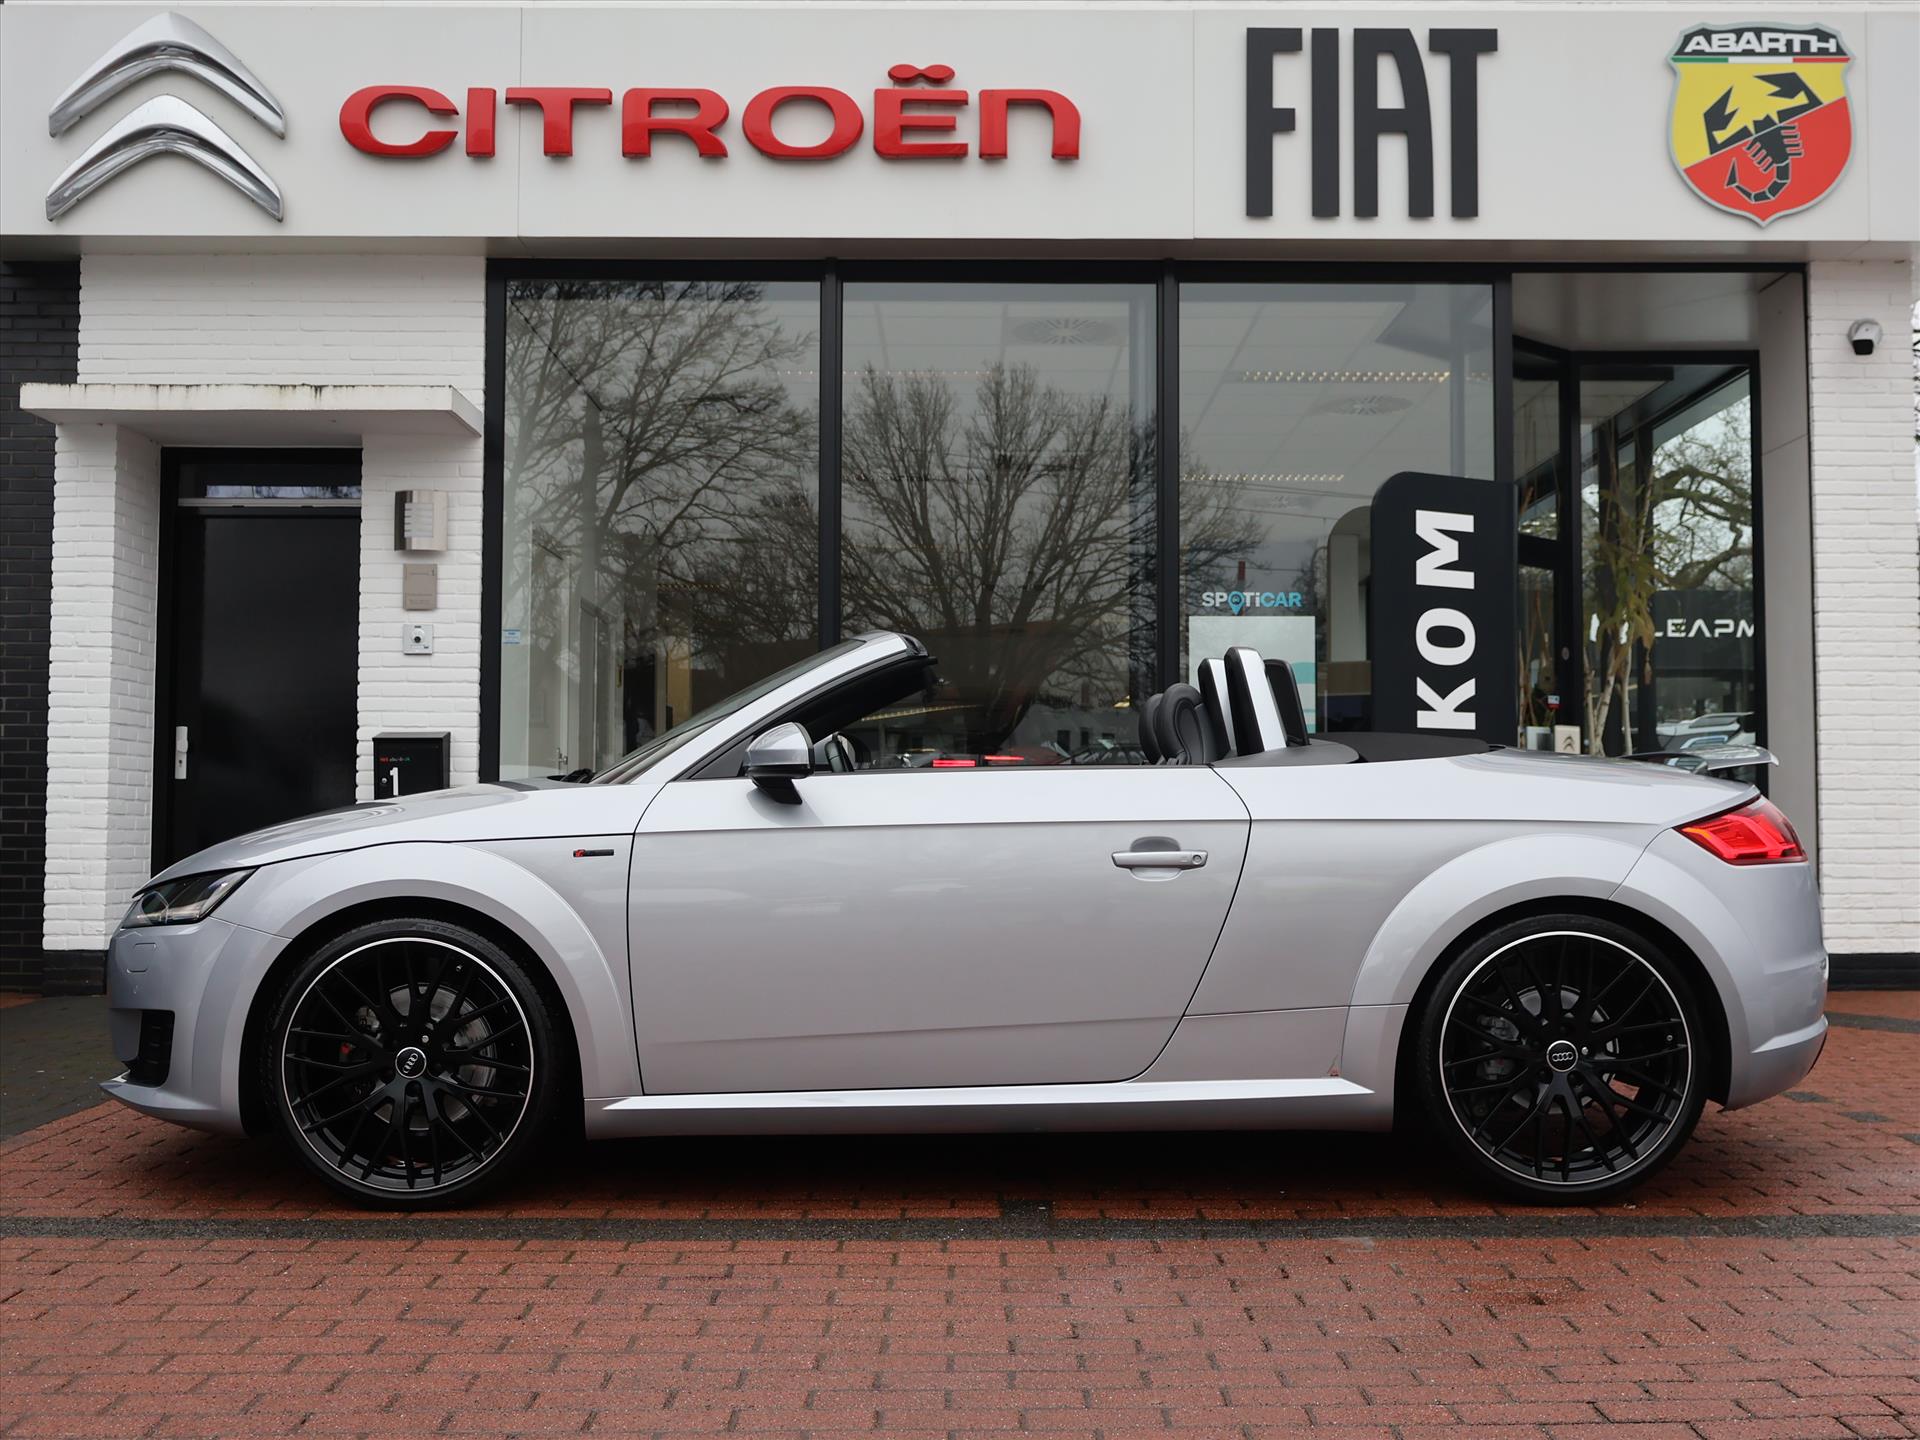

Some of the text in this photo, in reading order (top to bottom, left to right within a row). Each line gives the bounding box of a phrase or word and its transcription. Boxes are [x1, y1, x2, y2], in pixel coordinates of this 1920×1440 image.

[1684, 31, 1837, 53] ABARTH
[1246, 27, 1498, 218] FIAT
[389, 767, 399, 796] 1
